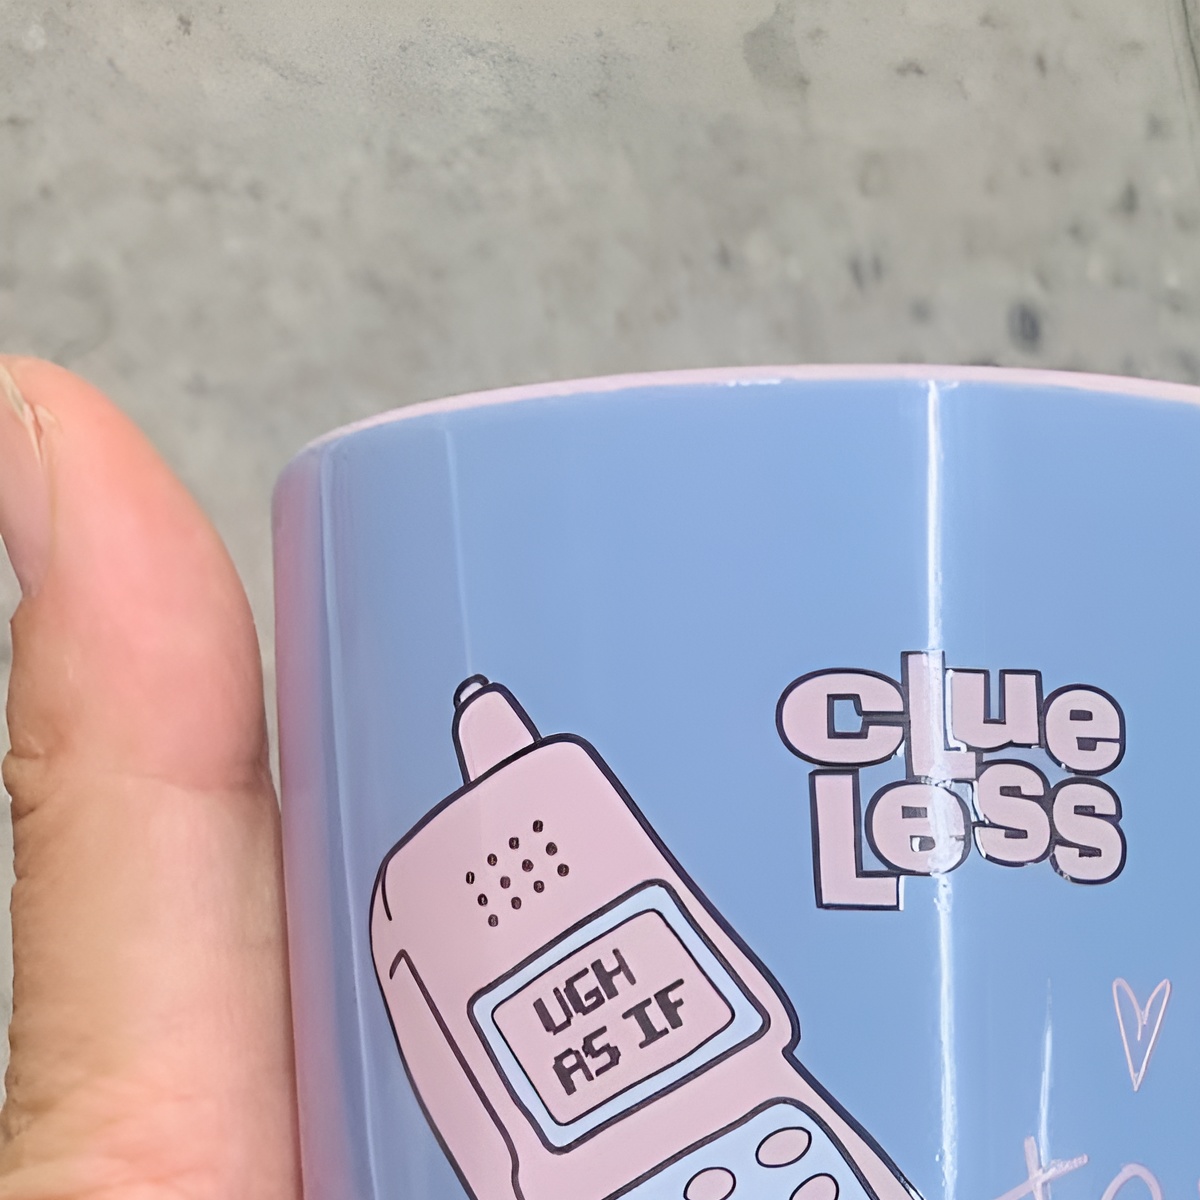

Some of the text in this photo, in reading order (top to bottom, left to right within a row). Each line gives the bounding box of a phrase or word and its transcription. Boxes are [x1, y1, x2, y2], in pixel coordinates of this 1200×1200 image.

[533, 948, 636, 1035] UGH
[552, 978, 684, 1096] AS IF
